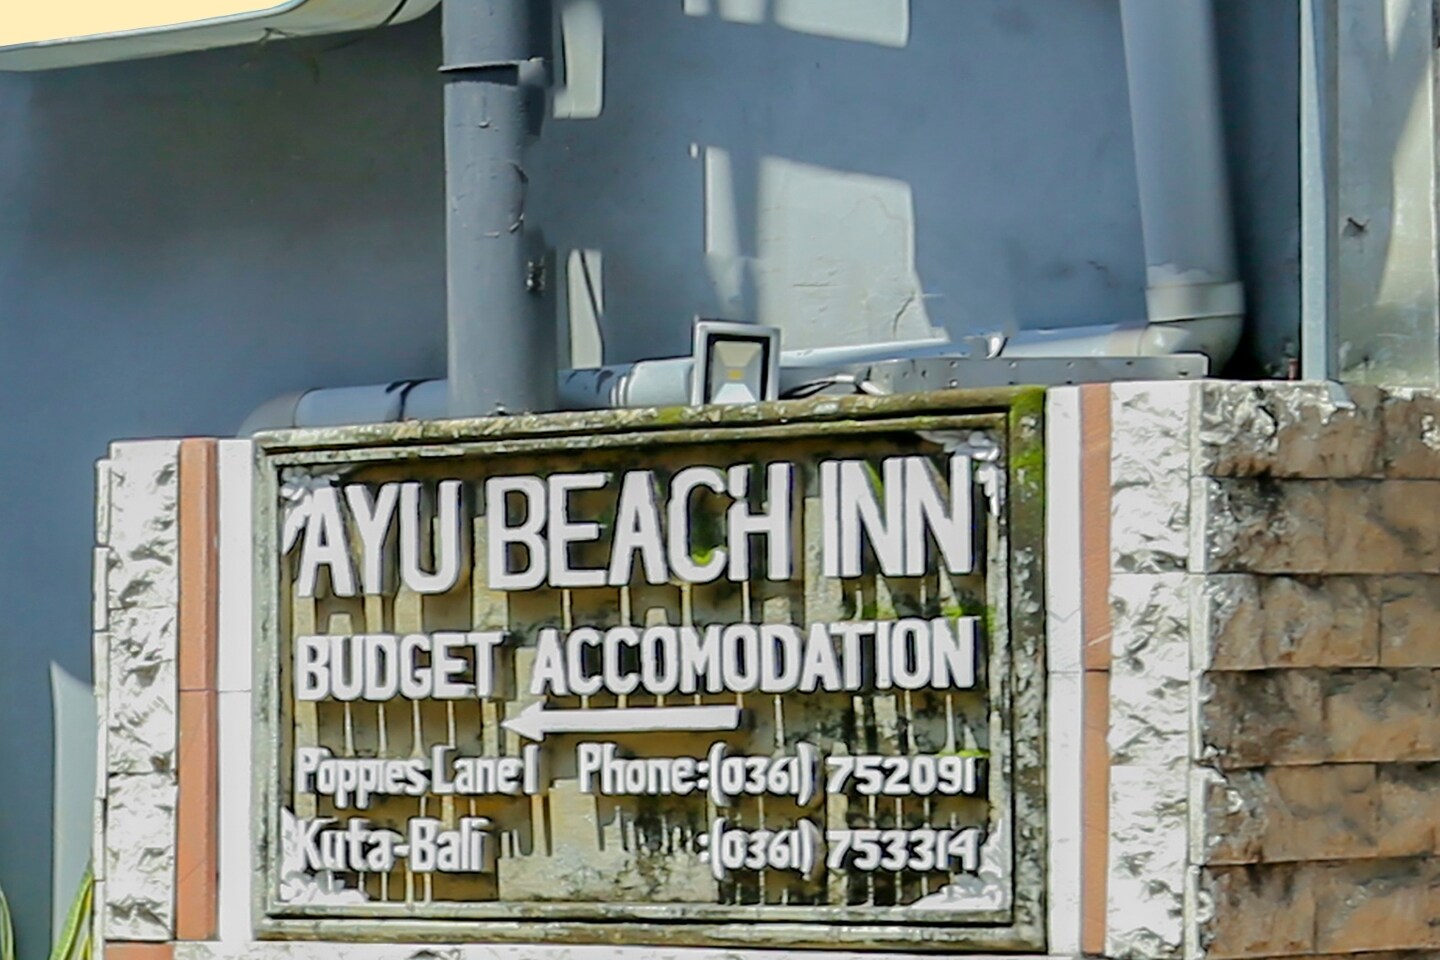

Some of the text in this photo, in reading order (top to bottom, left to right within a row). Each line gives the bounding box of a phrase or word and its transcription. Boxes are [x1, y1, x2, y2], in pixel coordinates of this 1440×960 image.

[297, 455, 973, 598] AYU BEACH INN
[296, 616, 981, 701] BUDGET ACCOMODATION
[296, 746, 428, 809] Poppies
[826, 754, 977, 796] 752091
[297, 816, 491, 872] Kuta-Bali
[826, 827, 982, 872] 753314
